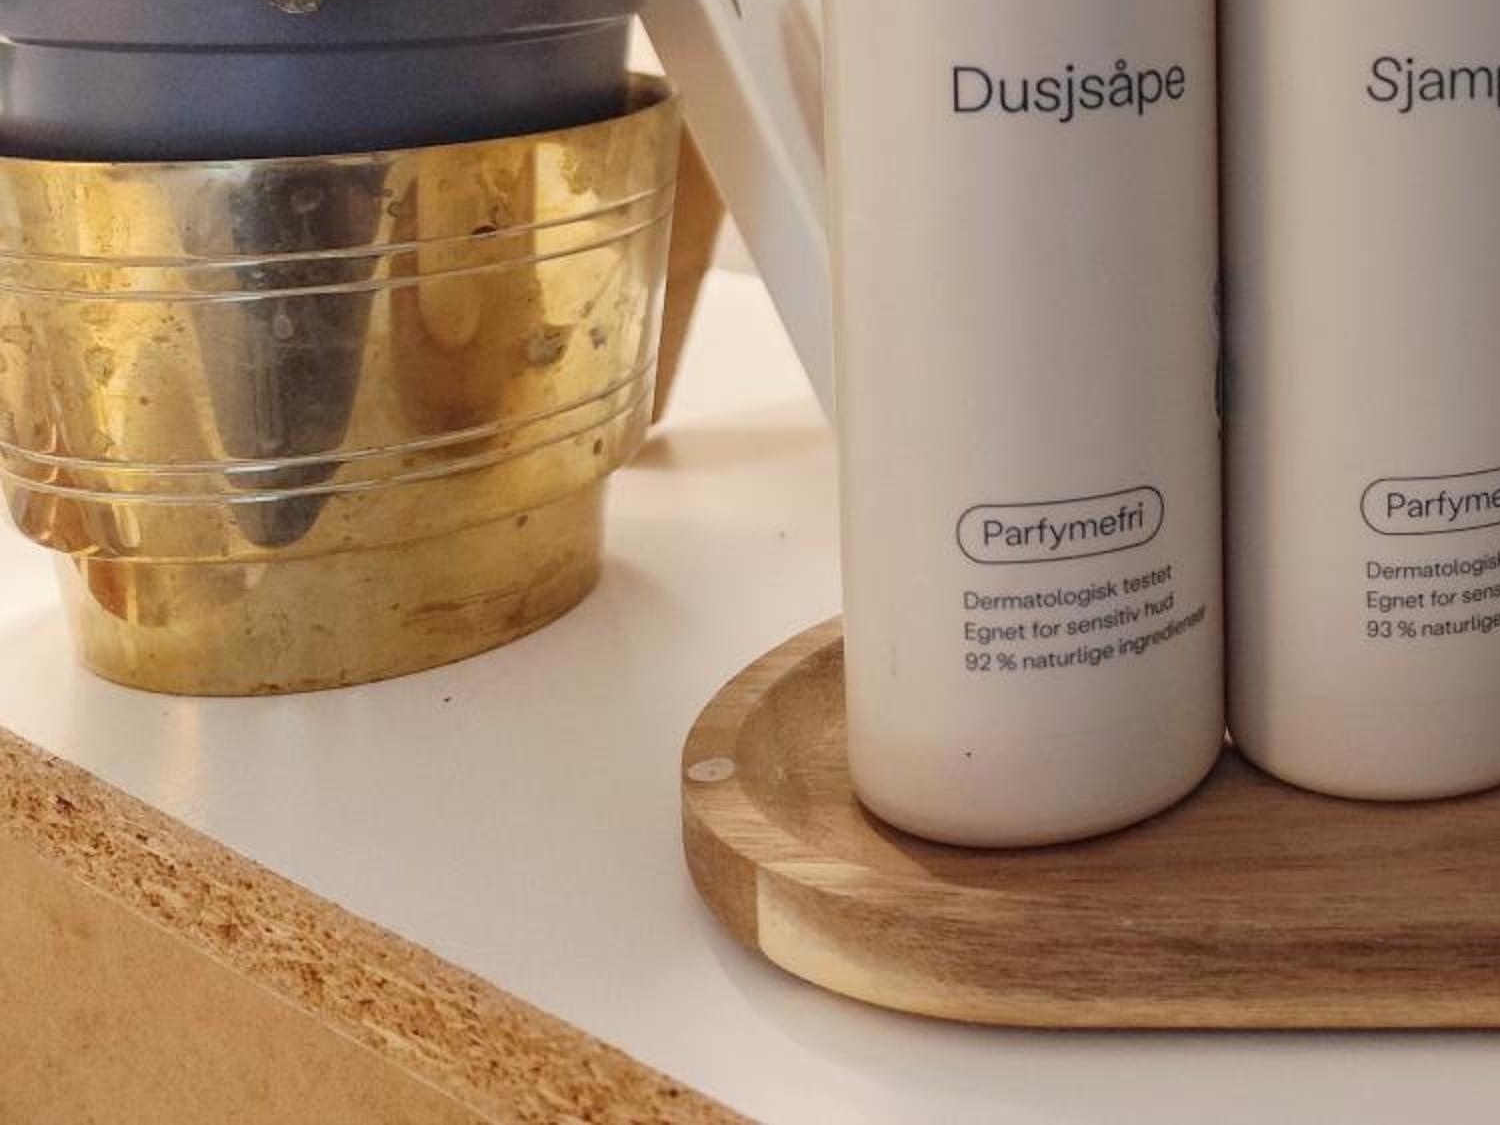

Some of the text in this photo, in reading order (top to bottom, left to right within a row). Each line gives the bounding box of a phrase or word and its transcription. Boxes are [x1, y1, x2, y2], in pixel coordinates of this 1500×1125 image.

[952, 58, 1186, 123] Dusjsåpe
[983, 502, 1144, 550] Parfymefri
[963, 564, 1172, 610] Dermatologisk testet
[1366, 591, 1424, 613] Egnet
[1431, 590, 1456, 607] for
[964, 621, 1025, 646] Egnet
[1033, 619, 1062, 639] for
[1067, 606, 1140, 635] sensitiv
[1367, 620, 1393, 638] 93
[1399, 621, 1417, 637] %
[965, 653, 991, 672] 92
[997, 652, 1017, 671] %
[1023, 643, 1115, 671] naturlige
